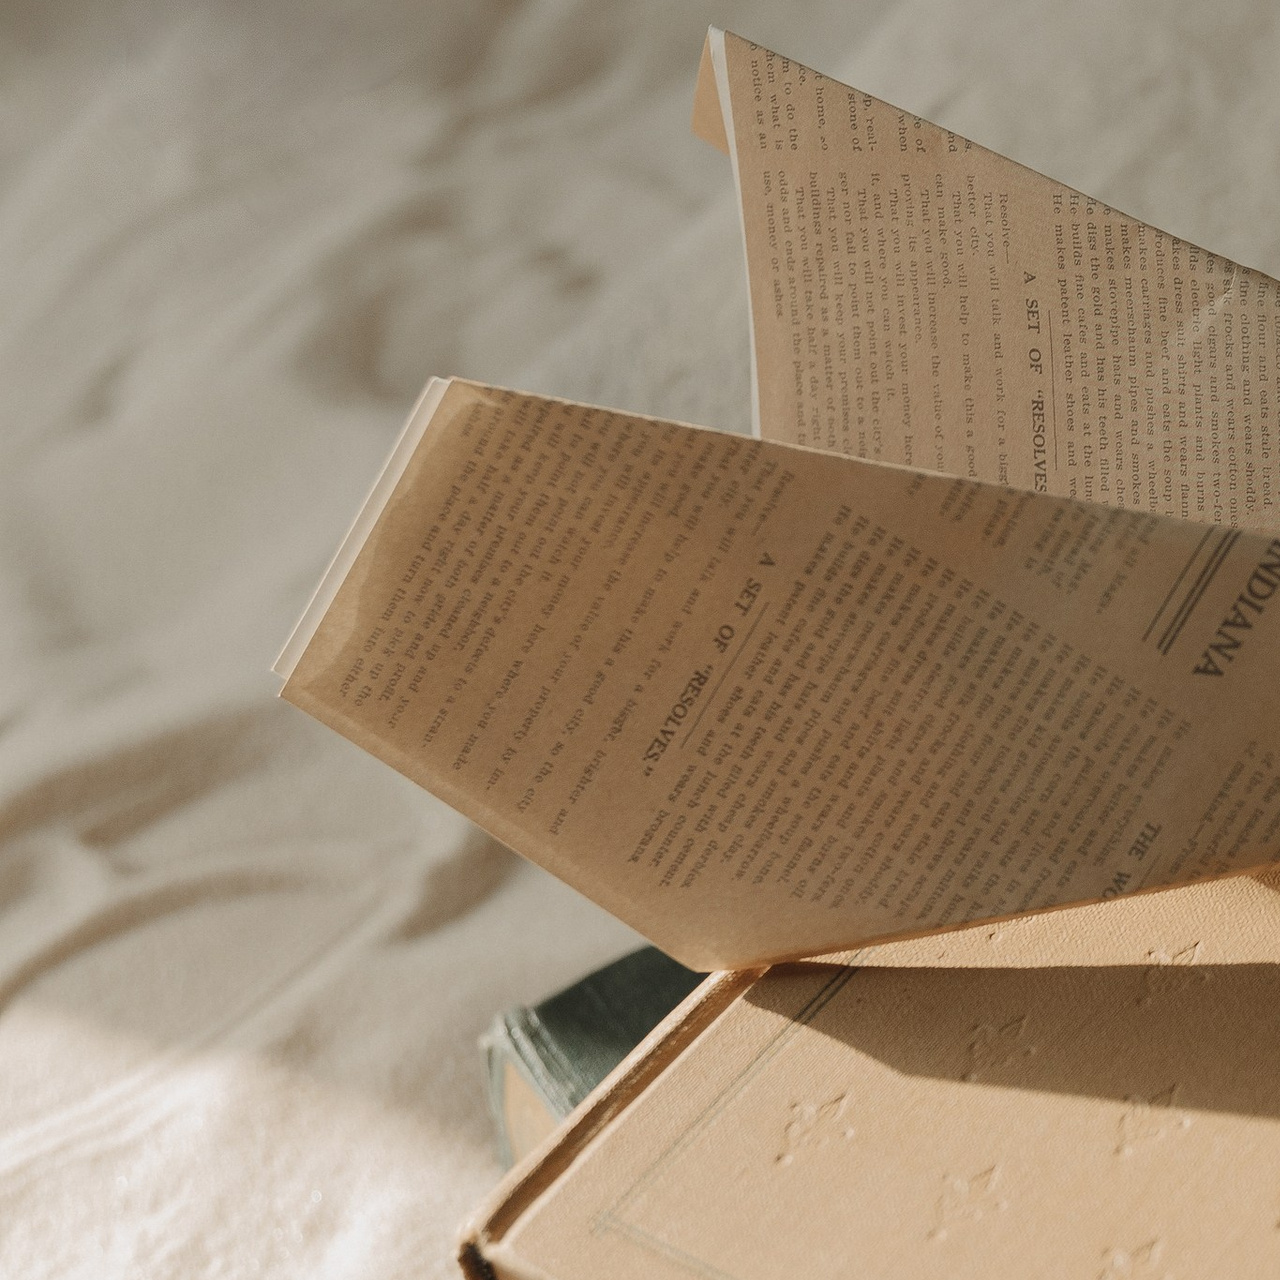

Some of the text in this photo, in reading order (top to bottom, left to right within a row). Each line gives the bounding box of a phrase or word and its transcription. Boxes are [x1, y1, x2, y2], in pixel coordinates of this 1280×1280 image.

[847, 92, 863, 152] stone of
[897, 113, 908, 152] when
[915, 138, 927, 153] of
[966, 175, 980, 256] better city.
[1069, 191, 1083, 216] He
[935, 173, 953, 289] can make good.
[1071, 223, 1083, 267] builds
[1023, 270, 1037, 285] A
[951, 190, 978, 477] That you will help to make this a good
[983, 191, 1007, 447] That you will talk and work for a
[1025, 298, 1041, 335] SET
[1052, 194, 1078, 467] He makes patent leather shoes and
[1077, 307, 1089, 345] cafes
[1257, 314, 1267, 349] flour
[1028, 347, 1043, 375] OF
[1086, 221, 1110, 492] digs the gold and has his teeth filled
[1103, 224, 1124, 471] makes stovepipe hats and wears
[1160, 330, 1171, 361] beef
[1240, 313, 1252, 373] clothing
[1080, 351, 1091, 378] and
[1120, 223, 1142, 505] makes meerschaum pipes and smokes
[1161, 368, 1172, 395] and
[1173, 276, 1189, 477] dress suit shirts and wears
[1258, 355, 1269, 382] and
[1081, 386, 1091, 415] eats
[1190, 279, 1206, 512] electric light plants and burns
[1242, 378, 1253, 406] and
[1259, 389, 1270, 419] eats
[1083, 422, 1092, 437] at
[1162, 403, 1172, 432] eats
[1243, 413, 1253, 455] wears
[1083, 444, 1094, 468] the
[1162, 439, 1173, 463] the
[1260, 425, 1272, 459] stale
[1162, 468, 1173, 502] soup
[1245, 461, 1257, 516] shoddy.
[1261, 466, 1274, 510] bread.
[642, 551, 776, 777] A SET OF “RESOLVES.”
[1128, 822, 1163, 862] THE
